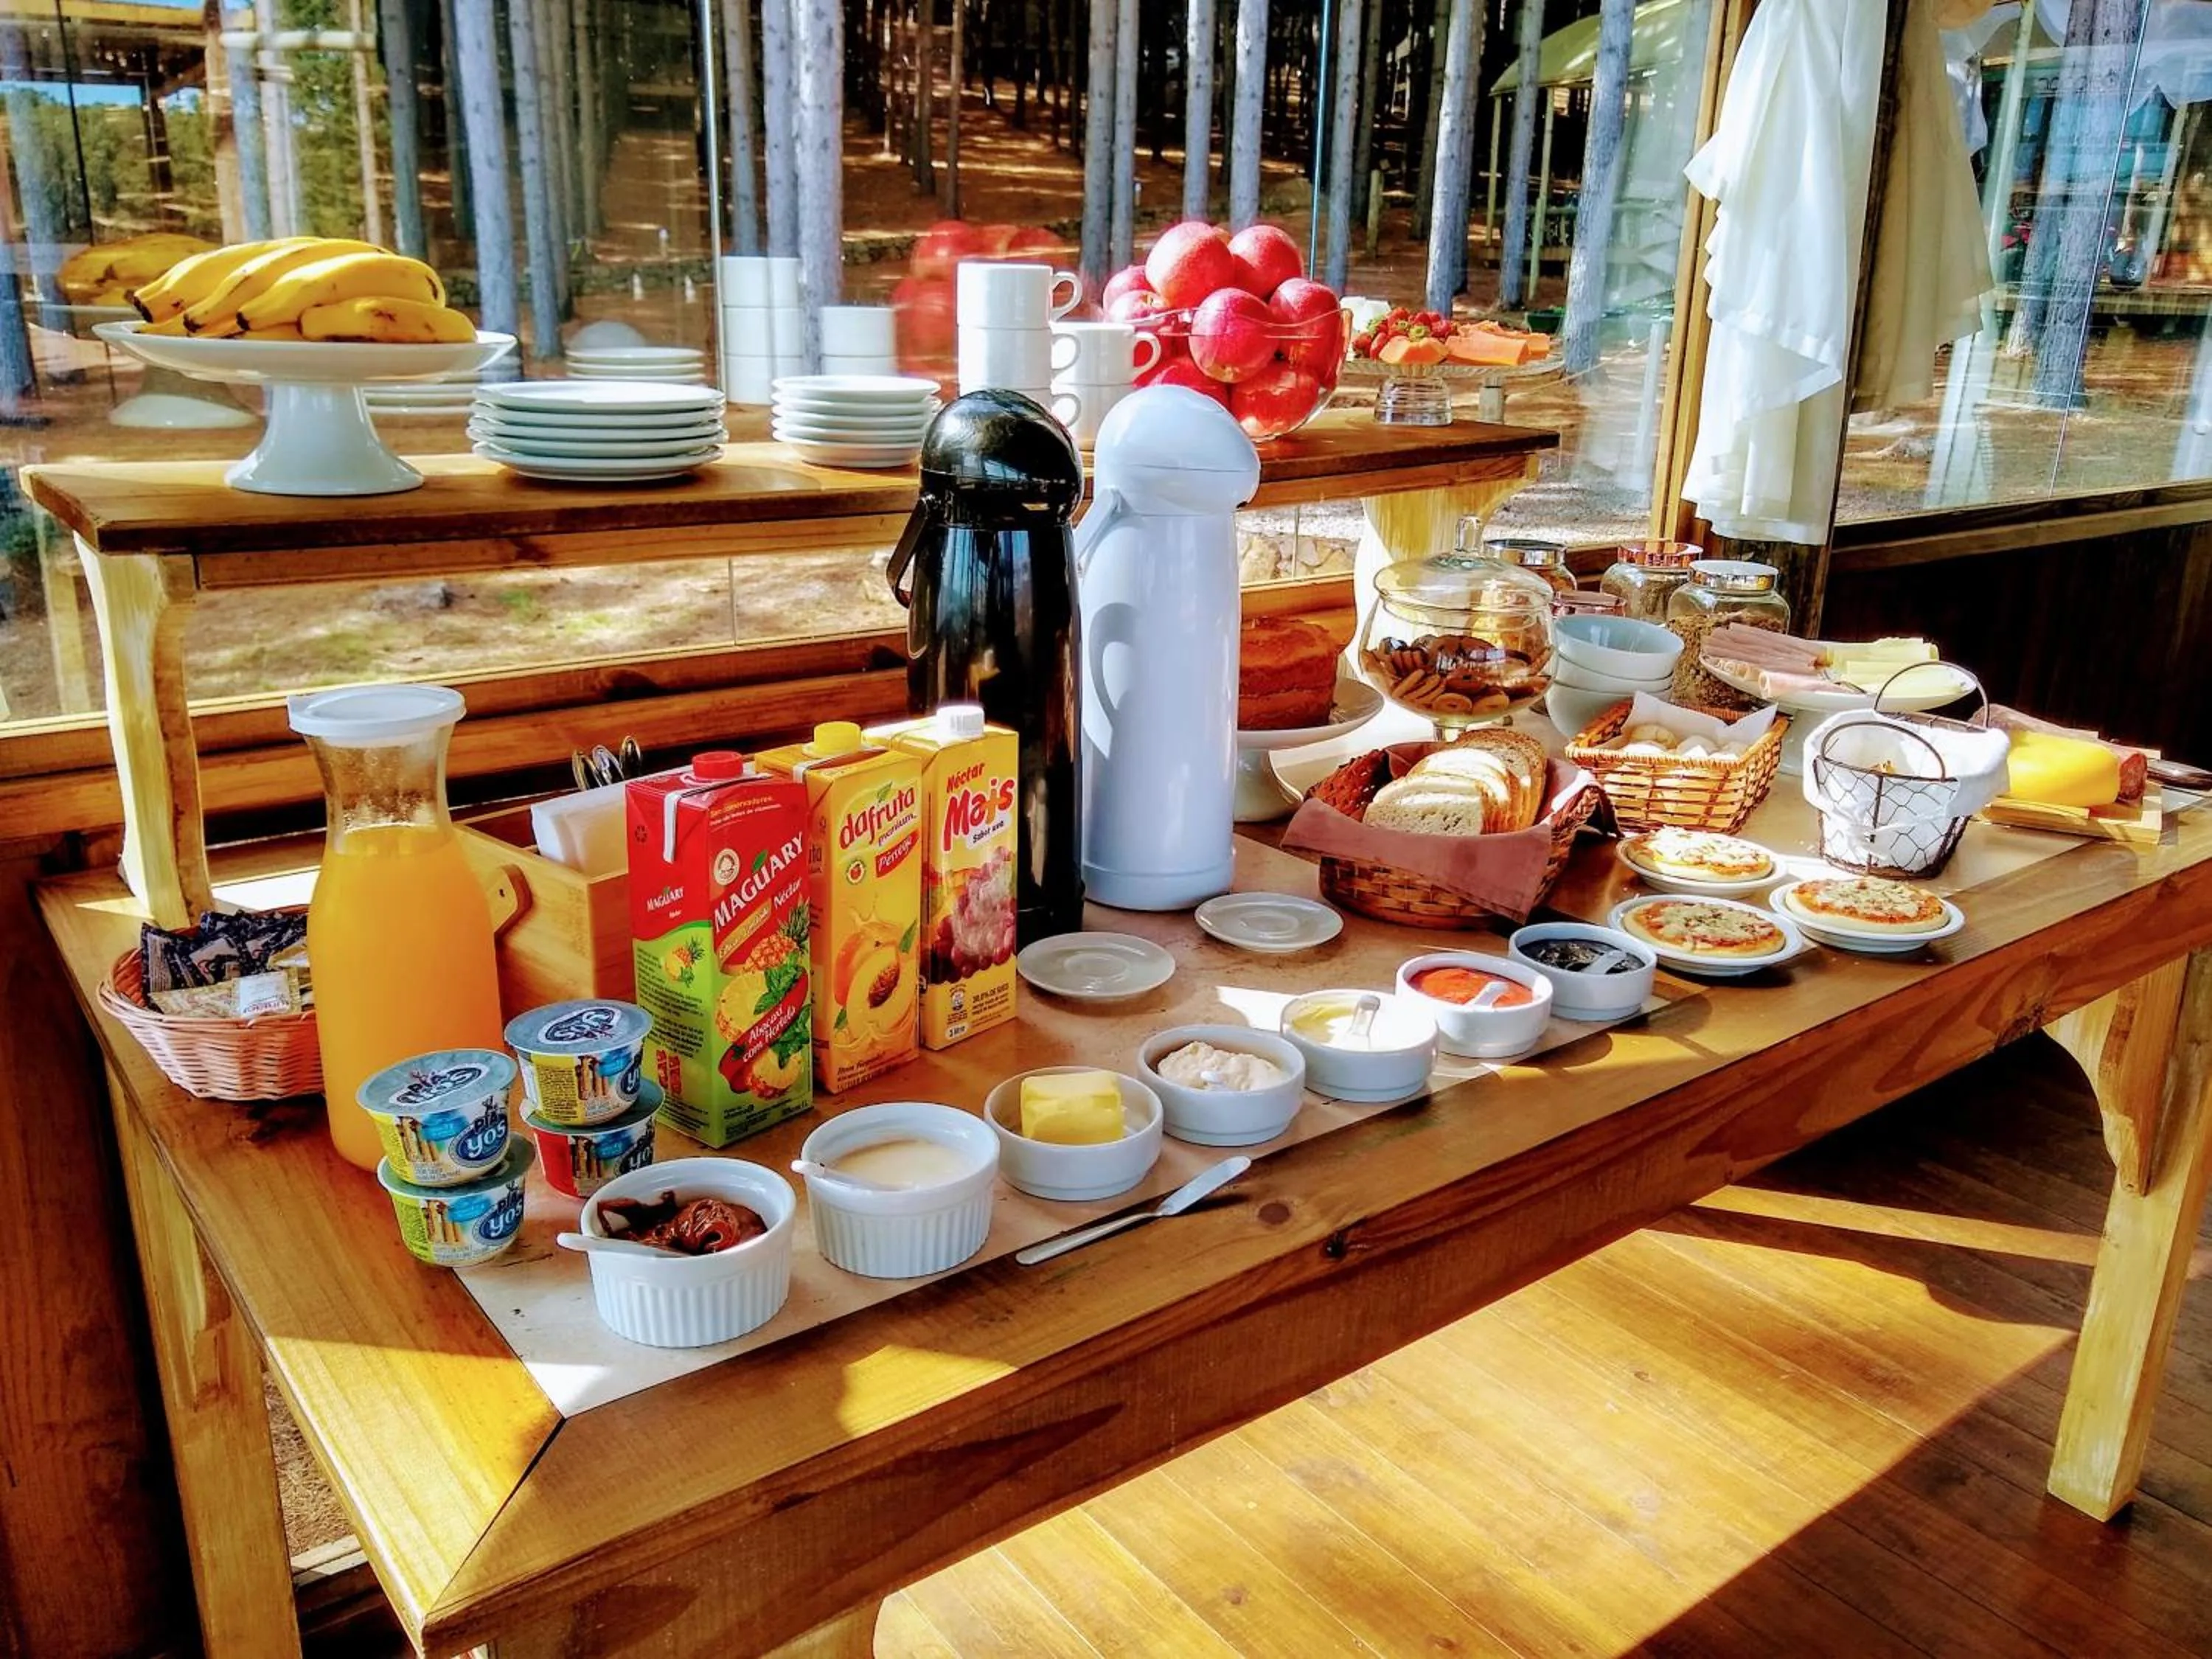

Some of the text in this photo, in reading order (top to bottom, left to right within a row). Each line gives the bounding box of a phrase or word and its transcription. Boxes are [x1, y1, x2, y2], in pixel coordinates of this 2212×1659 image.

[839, 787, 915, 849] dafruta
[944, 779, 1015, 851] Mais
[647, 886, 684, 912] MAGUARY
[714, 832, 803, 934] MAGUARY
[467, 1120, 506, 1158] yos
[488, 1198, 522, 1237] yos
